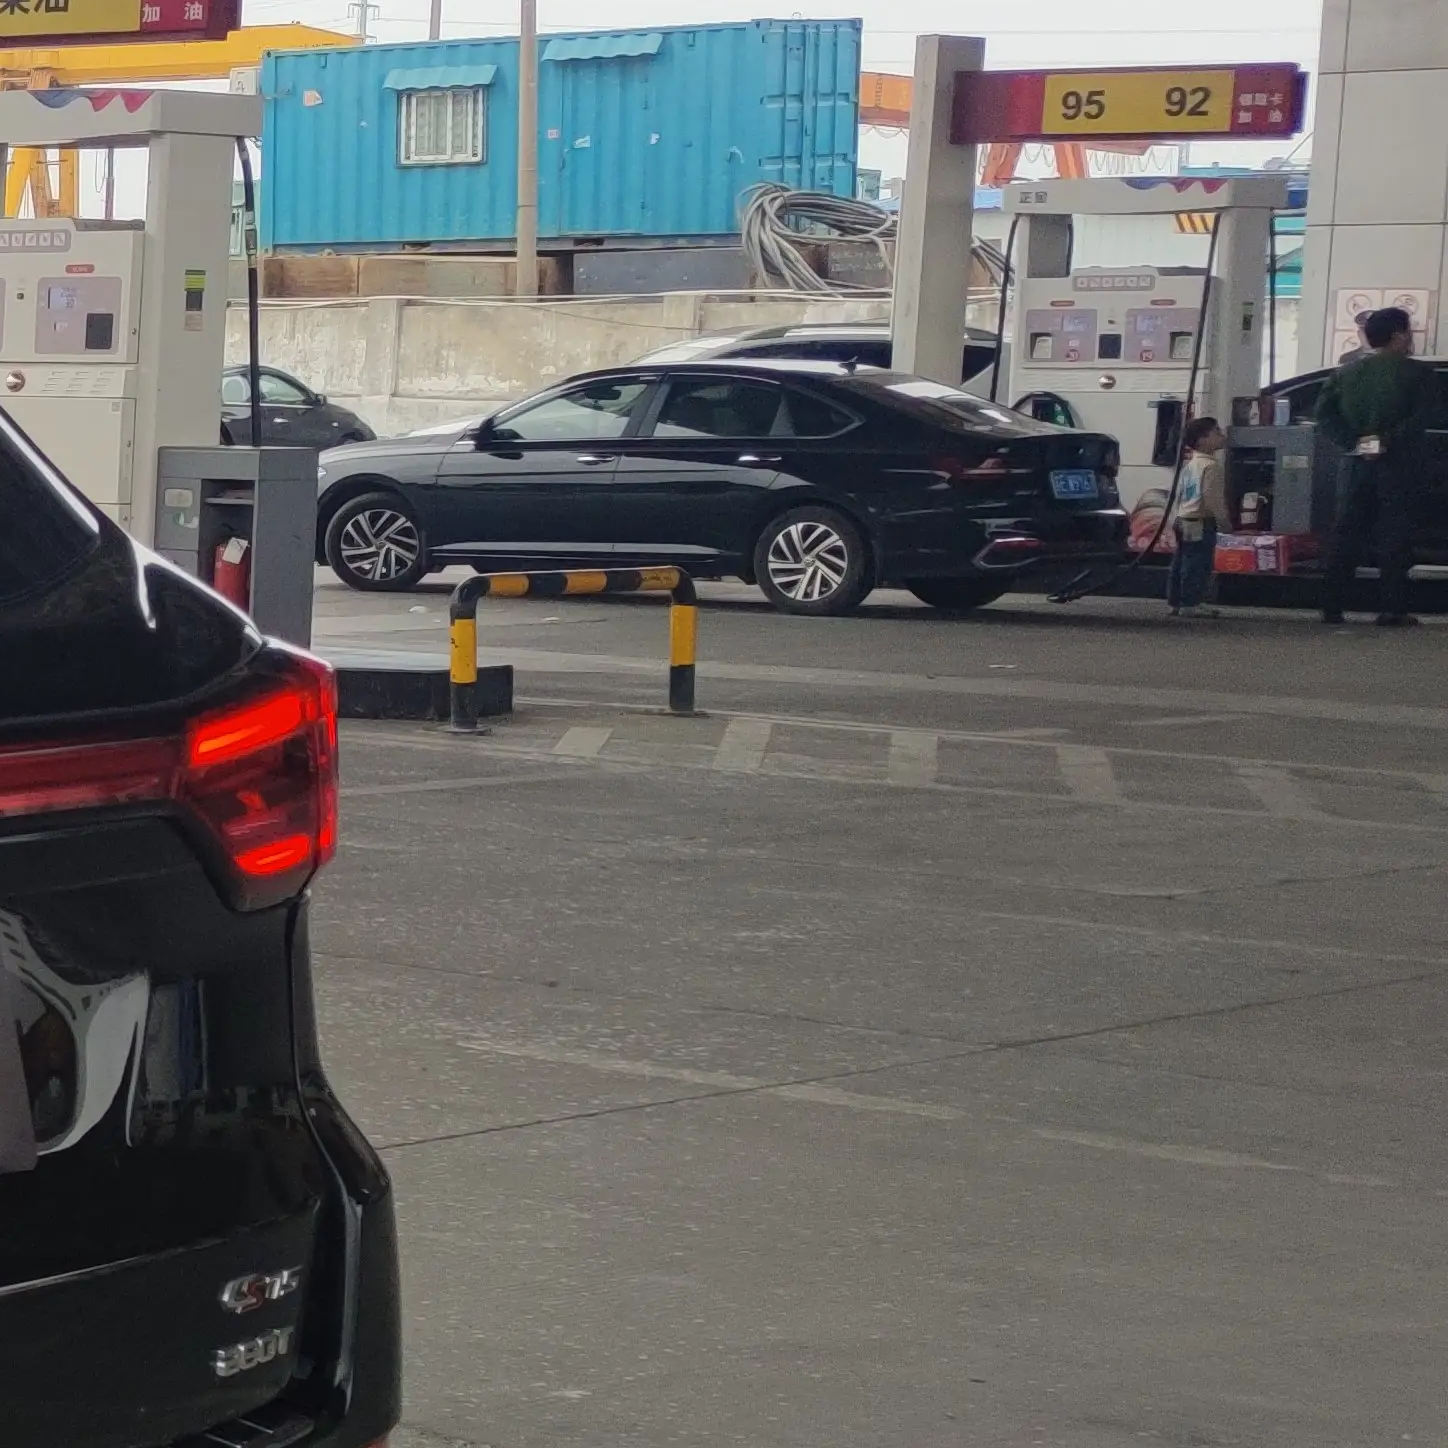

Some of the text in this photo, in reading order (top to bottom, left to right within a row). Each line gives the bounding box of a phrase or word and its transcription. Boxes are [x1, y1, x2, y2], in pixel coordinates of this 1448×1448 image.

[142, 1, 203, 23] 加油
[1061, 90, 1106, 120] 95
[1164, 86, 1212, 117] 92
[220, 1265, 302, 1314] CS75
